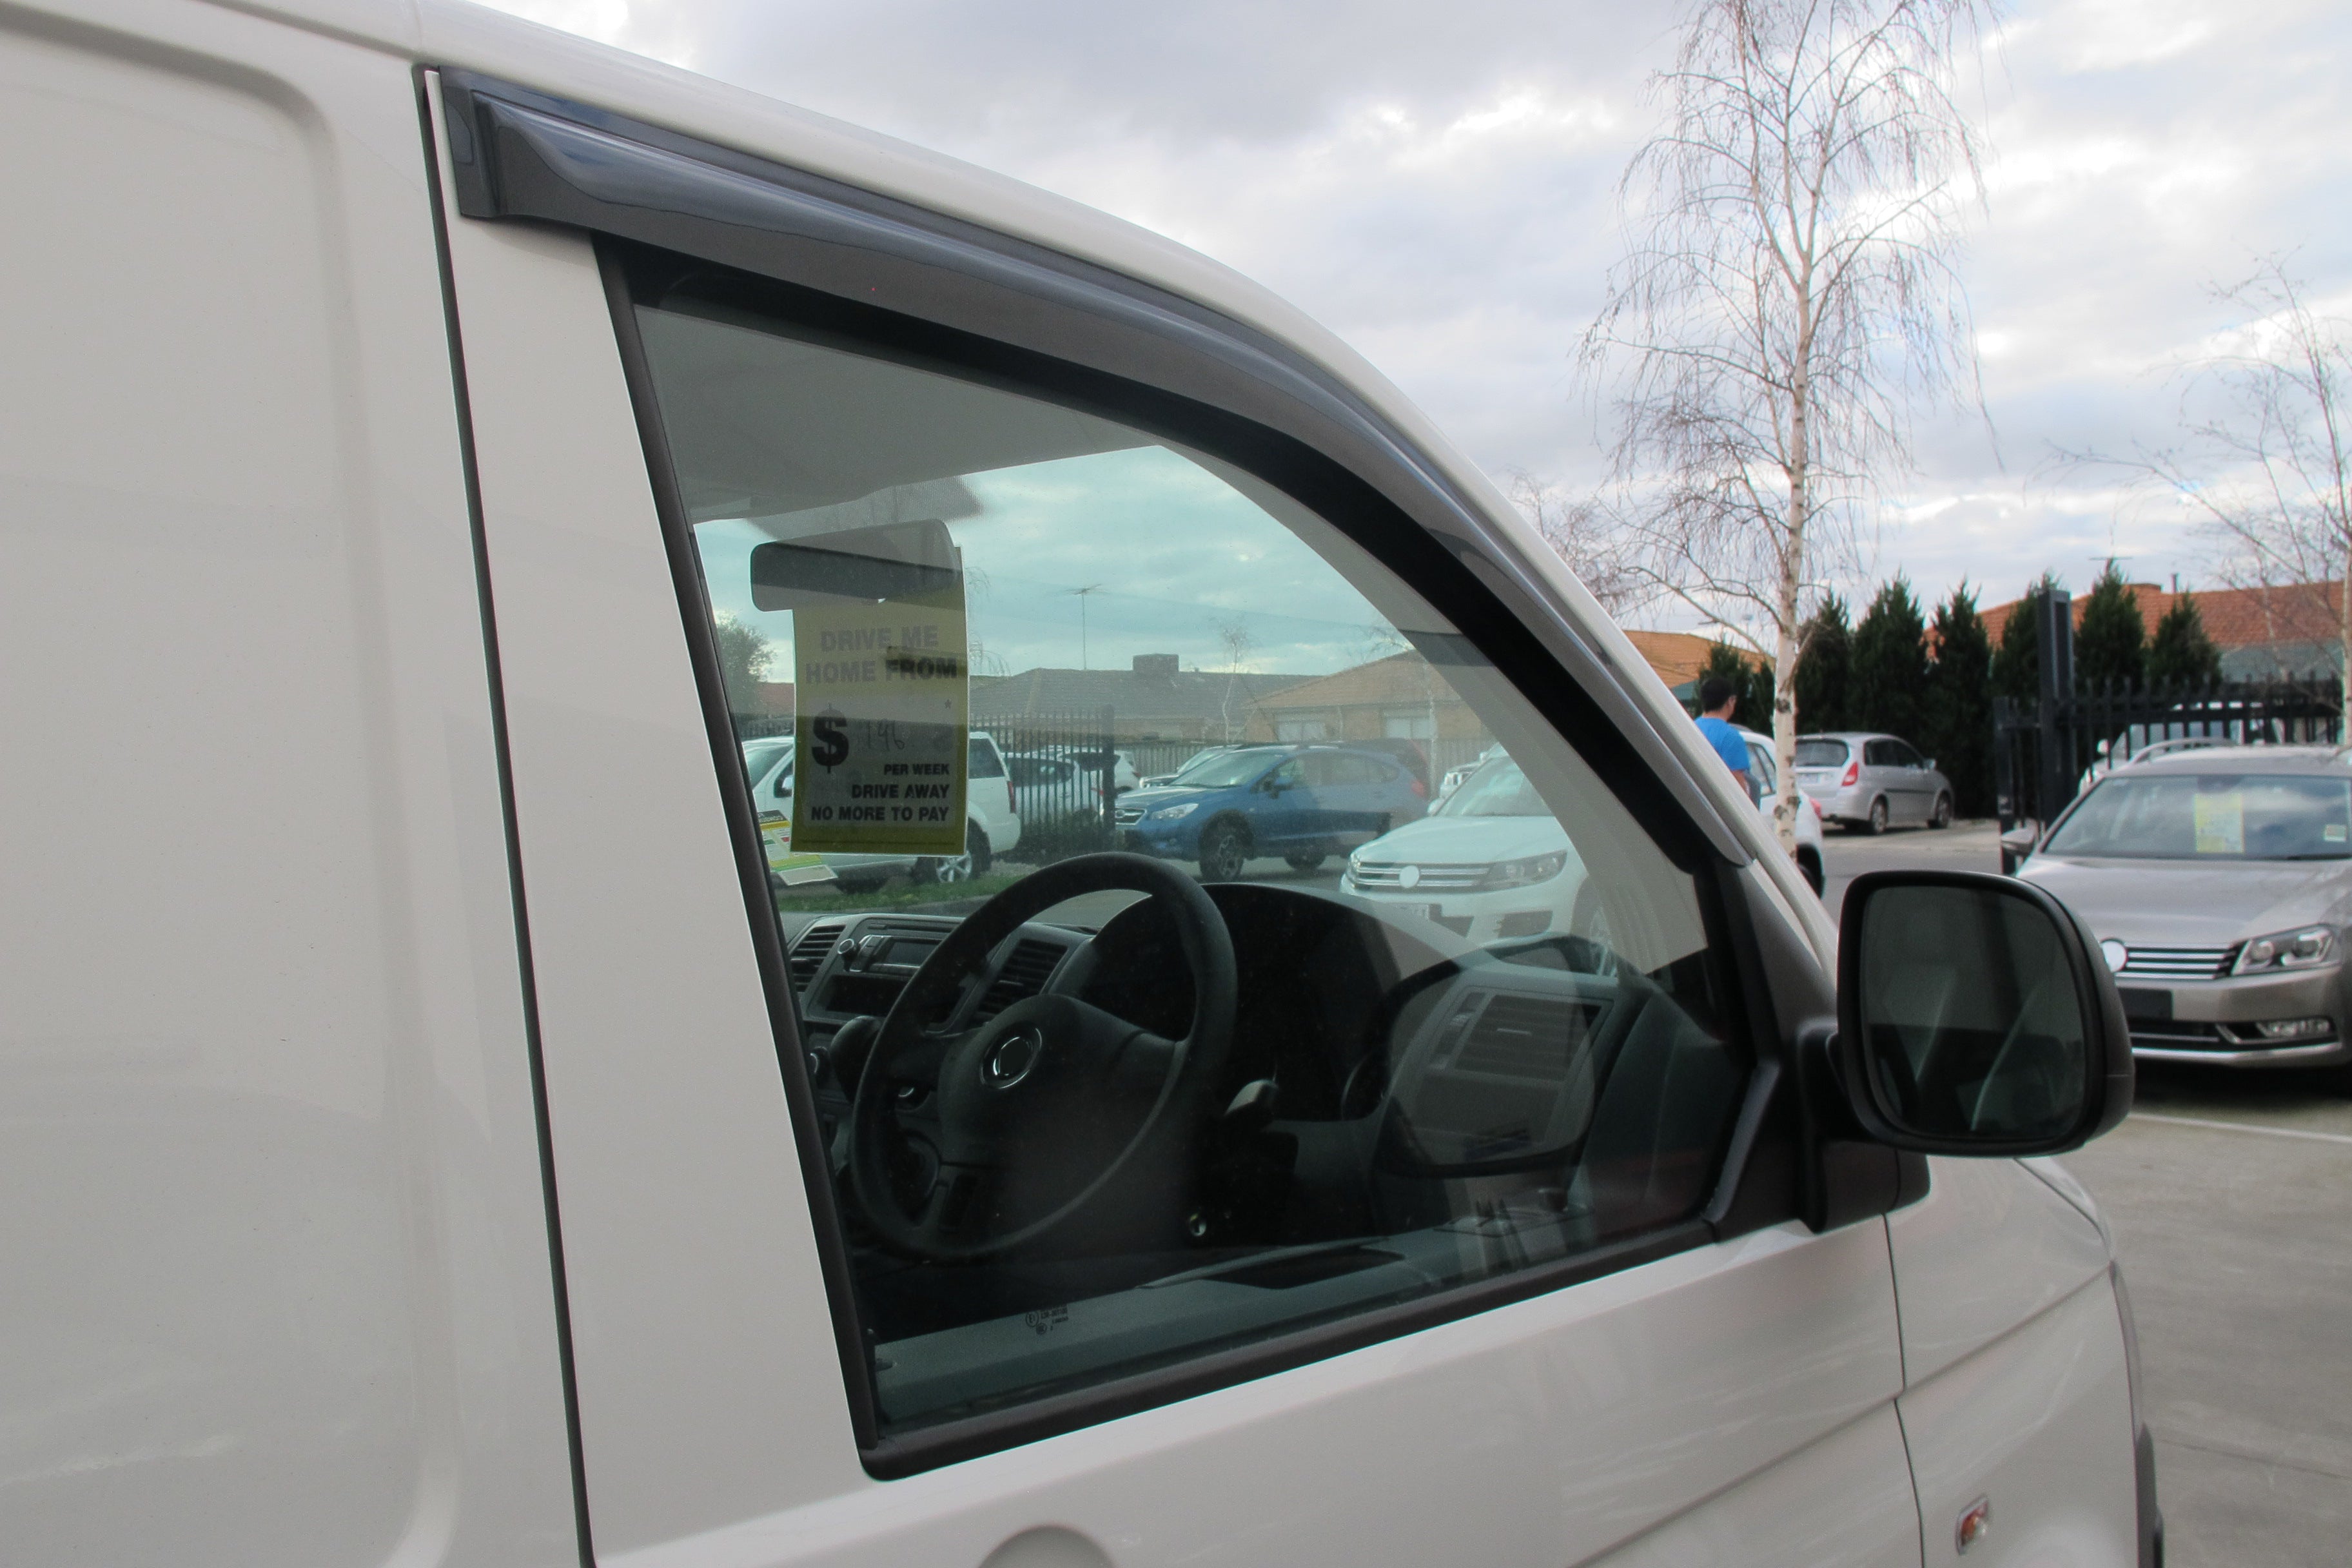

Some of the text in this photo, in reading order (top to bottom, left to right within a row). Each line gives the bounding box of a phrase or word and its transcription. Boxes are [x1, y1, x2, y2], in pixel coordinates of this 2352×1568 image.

[821, 625, 939, 651] DRIVE ME
[806, 656, 957, 683] HOME FROM
[811, 703, 849, 773] $
[884, 763, 950, 775] PER WEEK
[852, 784, 950, 799] DRIVE AWAY
[811, 807, 950, 821] NO MORE TO PAY
